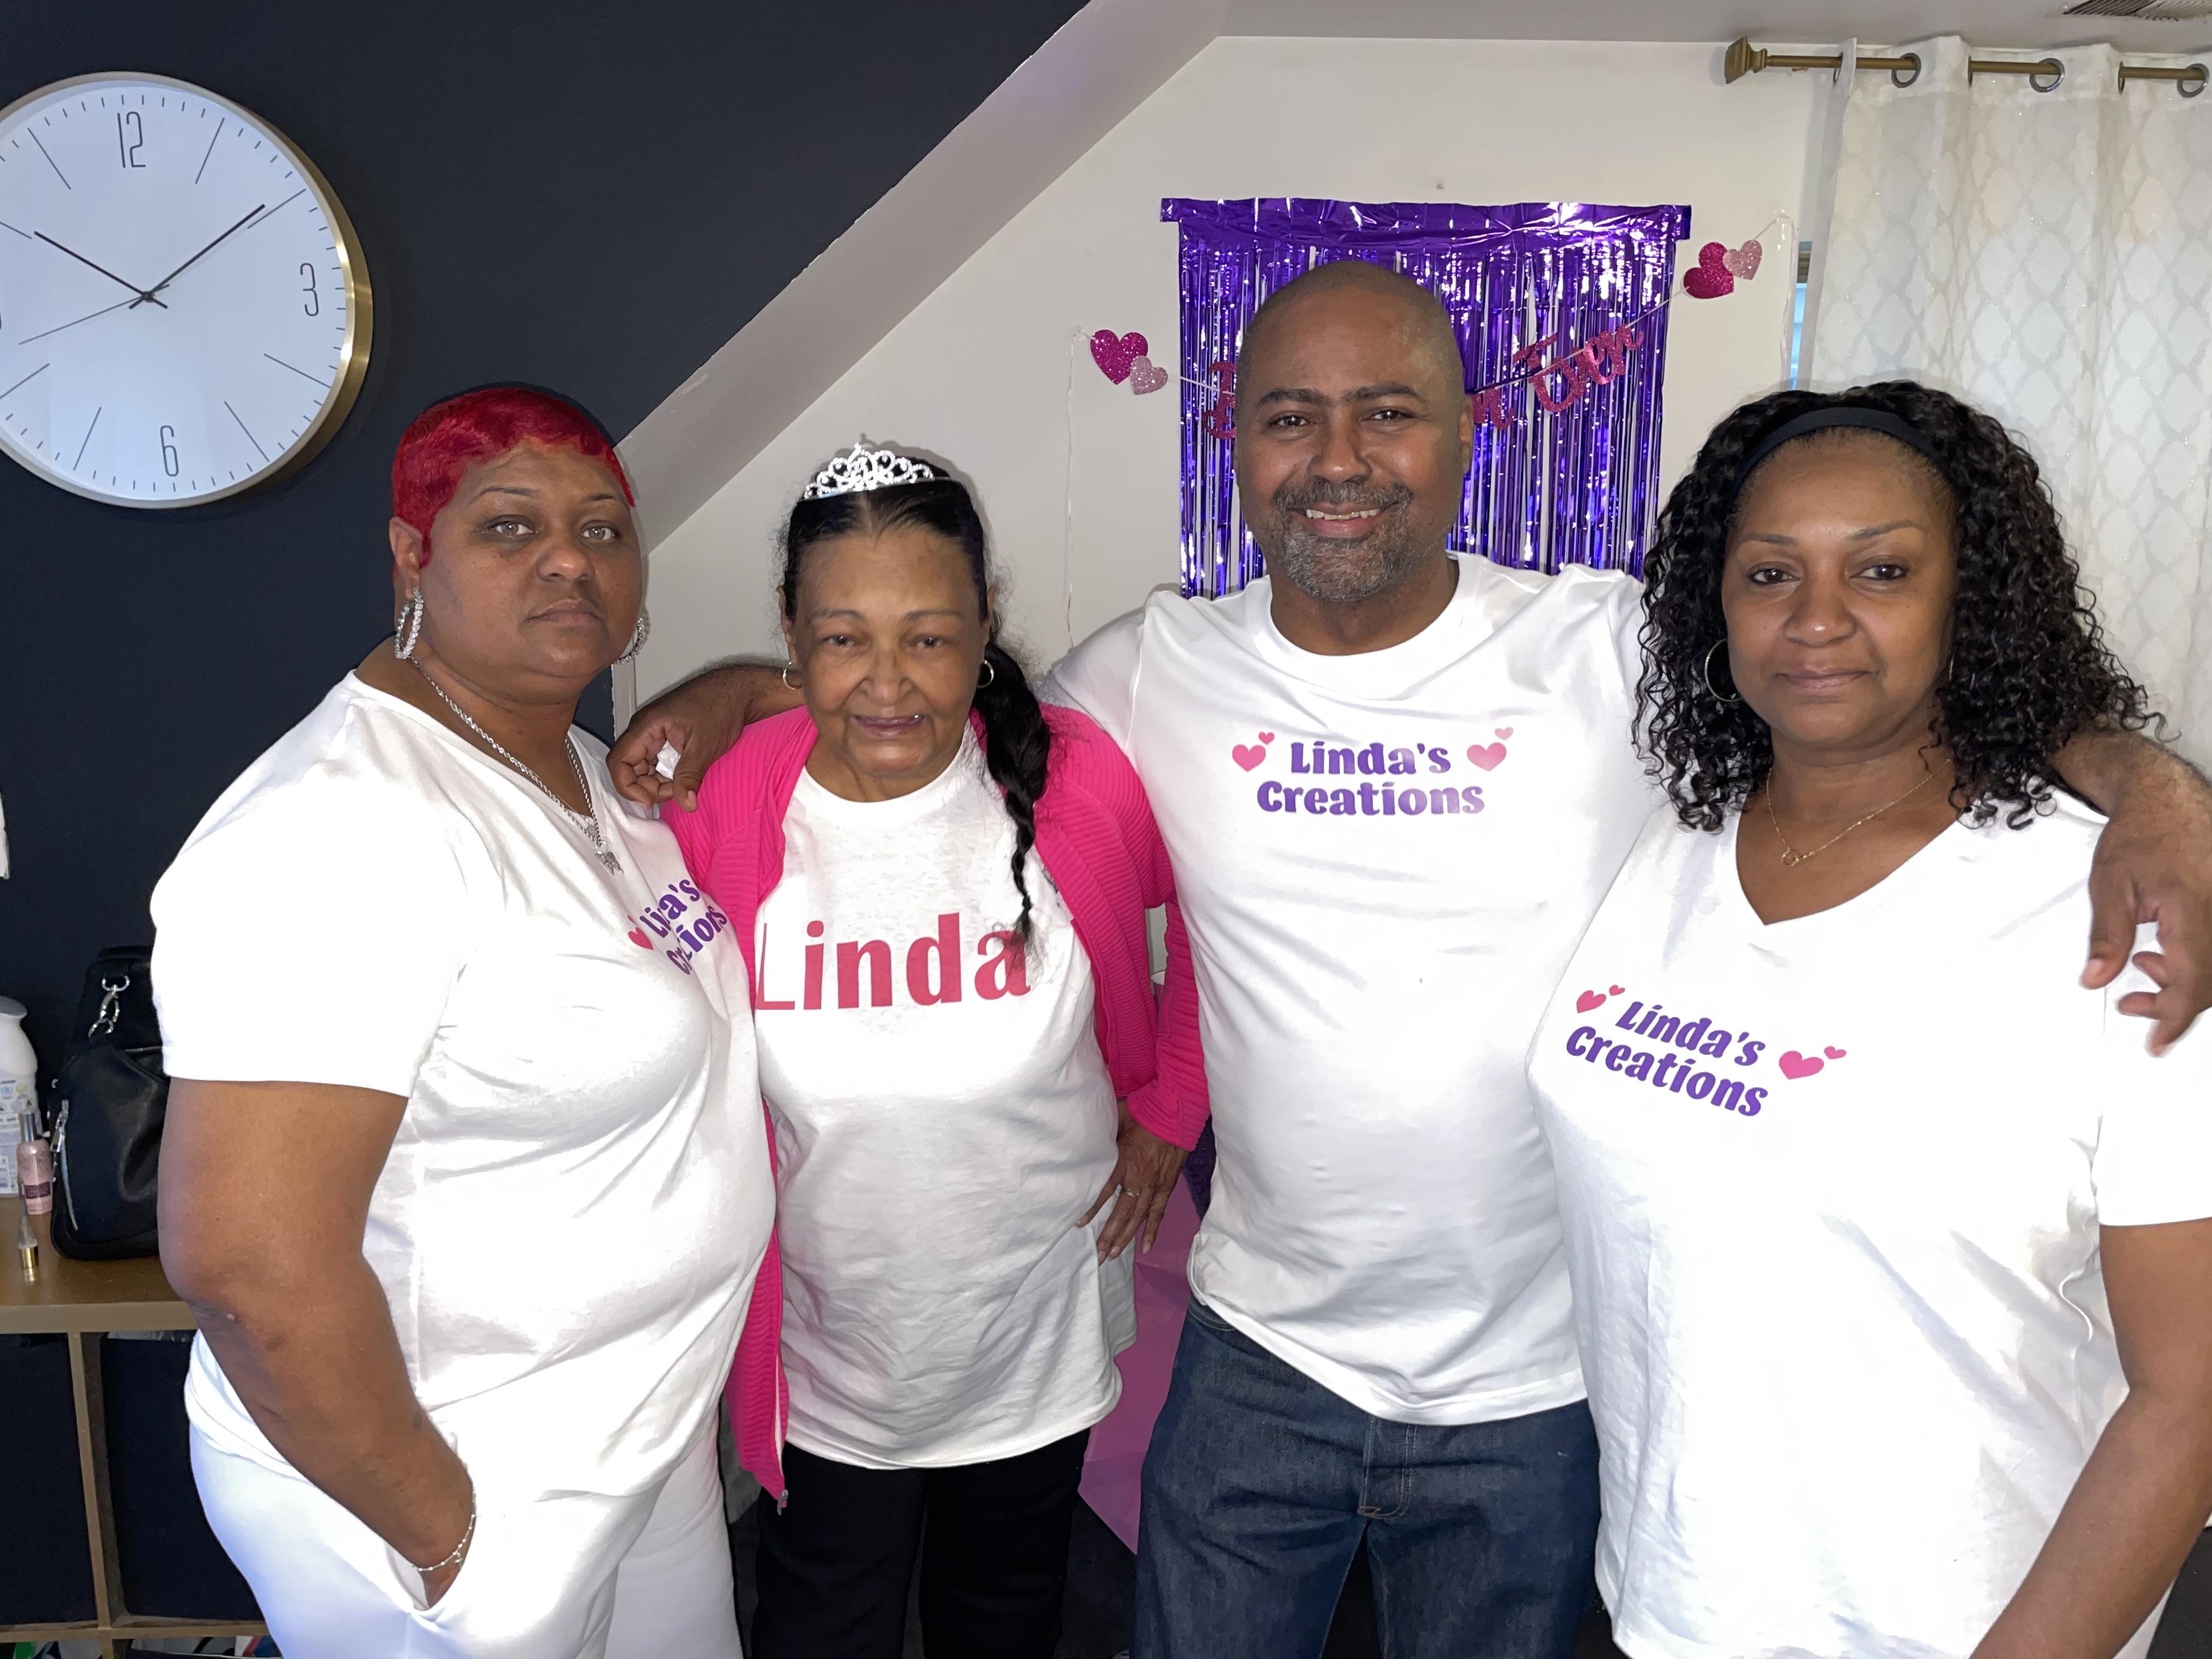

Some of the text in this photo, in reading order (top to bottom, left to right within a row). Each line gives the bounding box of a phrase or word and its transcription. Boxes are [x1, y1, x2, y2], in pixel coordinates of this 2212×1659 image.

[117, 111, 146, 168] 12
[300, 262, 319, 317] 3
[160, 425, 179, 477] 6
[1290, 740, 1452, 775] Linda's
[1256, 780, 1486, 816] Creations
[756, 912, 1031, 1011] Linda
[1615, 1001, 1767, 1066] Linda's
[1566, 1025, 1768, 1116] Creations
